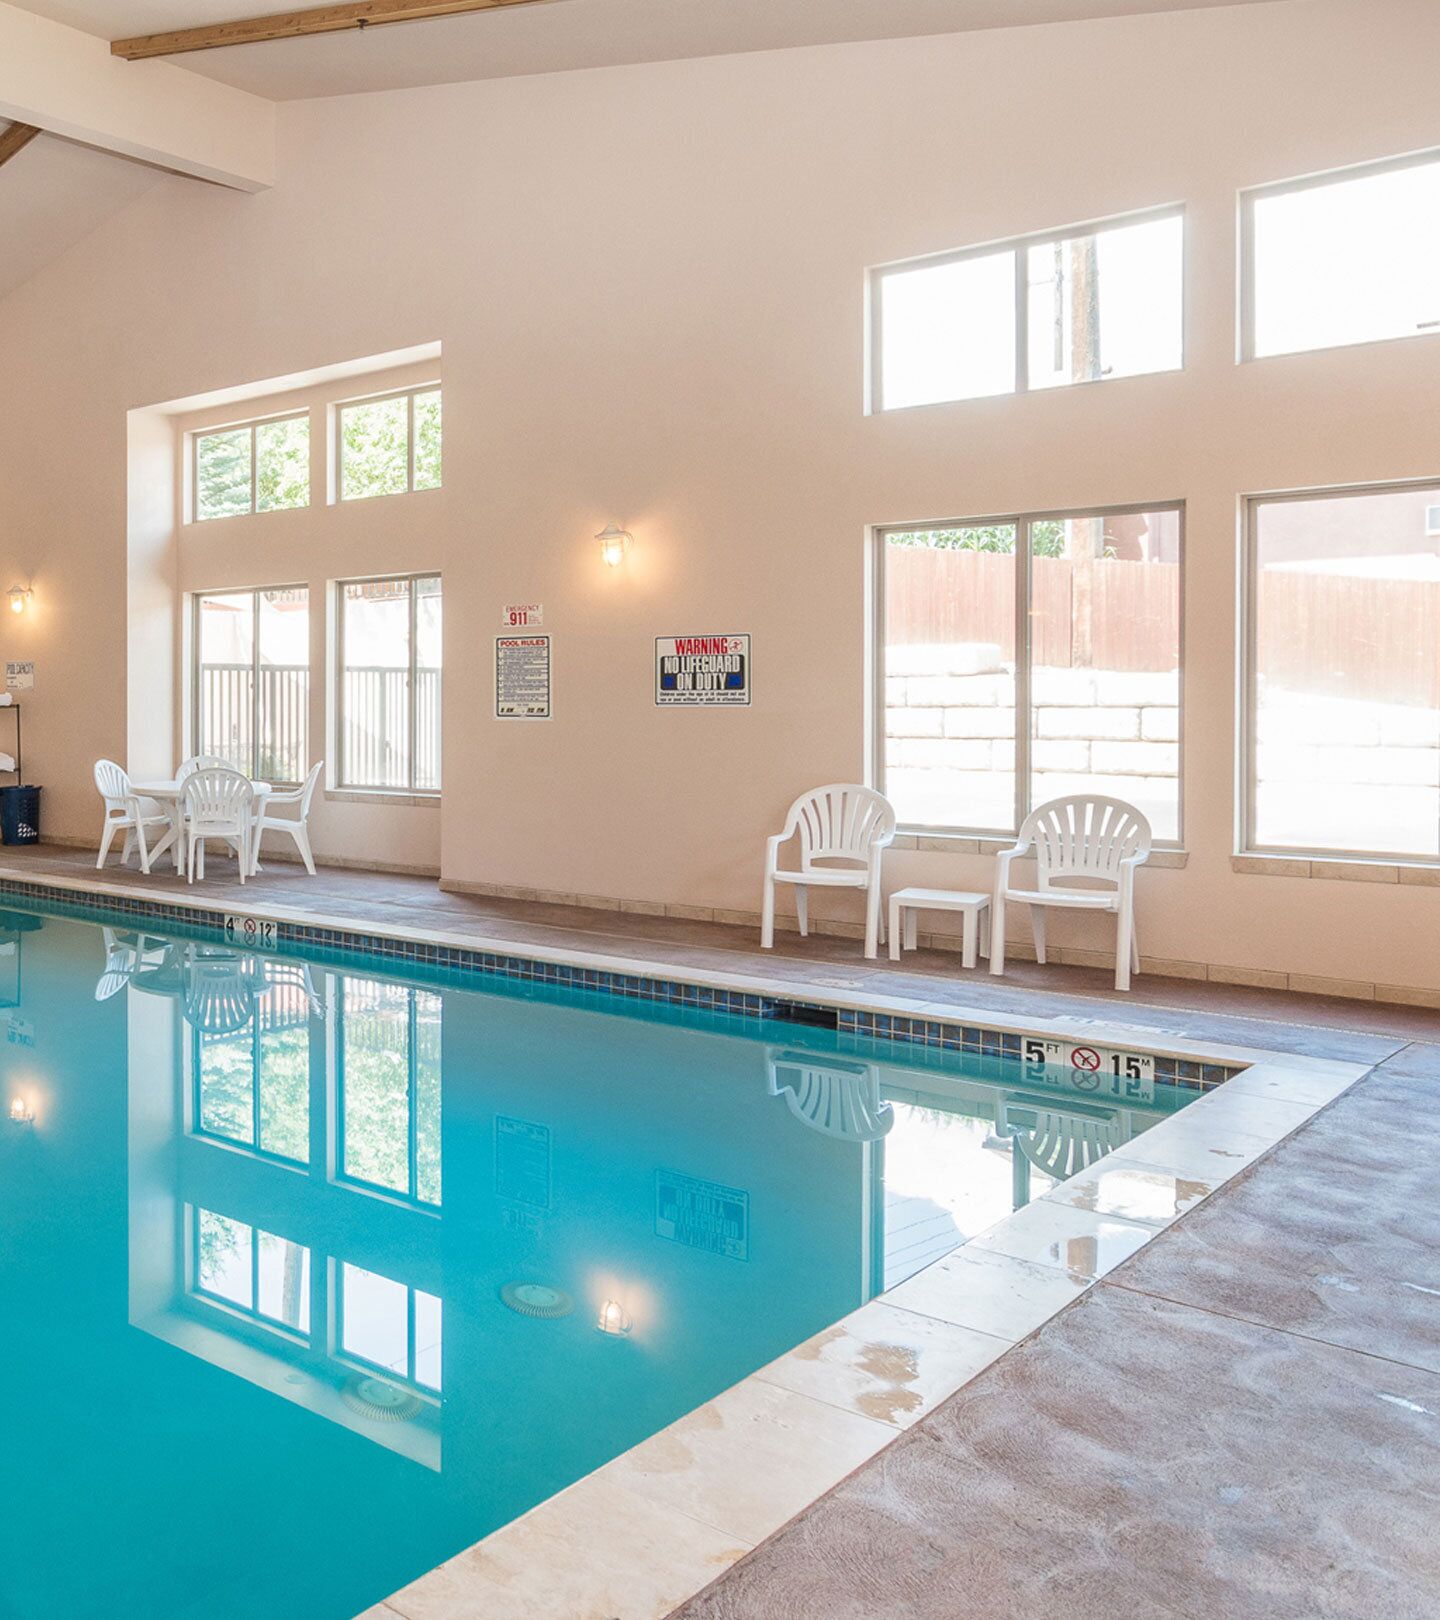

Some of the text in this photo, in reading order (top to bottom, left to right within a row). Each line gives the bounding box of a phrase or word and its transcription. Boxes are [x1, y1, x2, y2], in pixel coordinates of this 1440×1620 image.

[509, 612, 527, 625] 911
[674, 637, 728, 655] WARNING
[664, 655, 740, 674] NO LIFEGUARD
[676, 672, 726, 690] ON DUTY
[226, 917, 234, 930] 4
[1026, 1040, 1045, 1063] 5
[1046, 1044, 1059, 1053] FT
